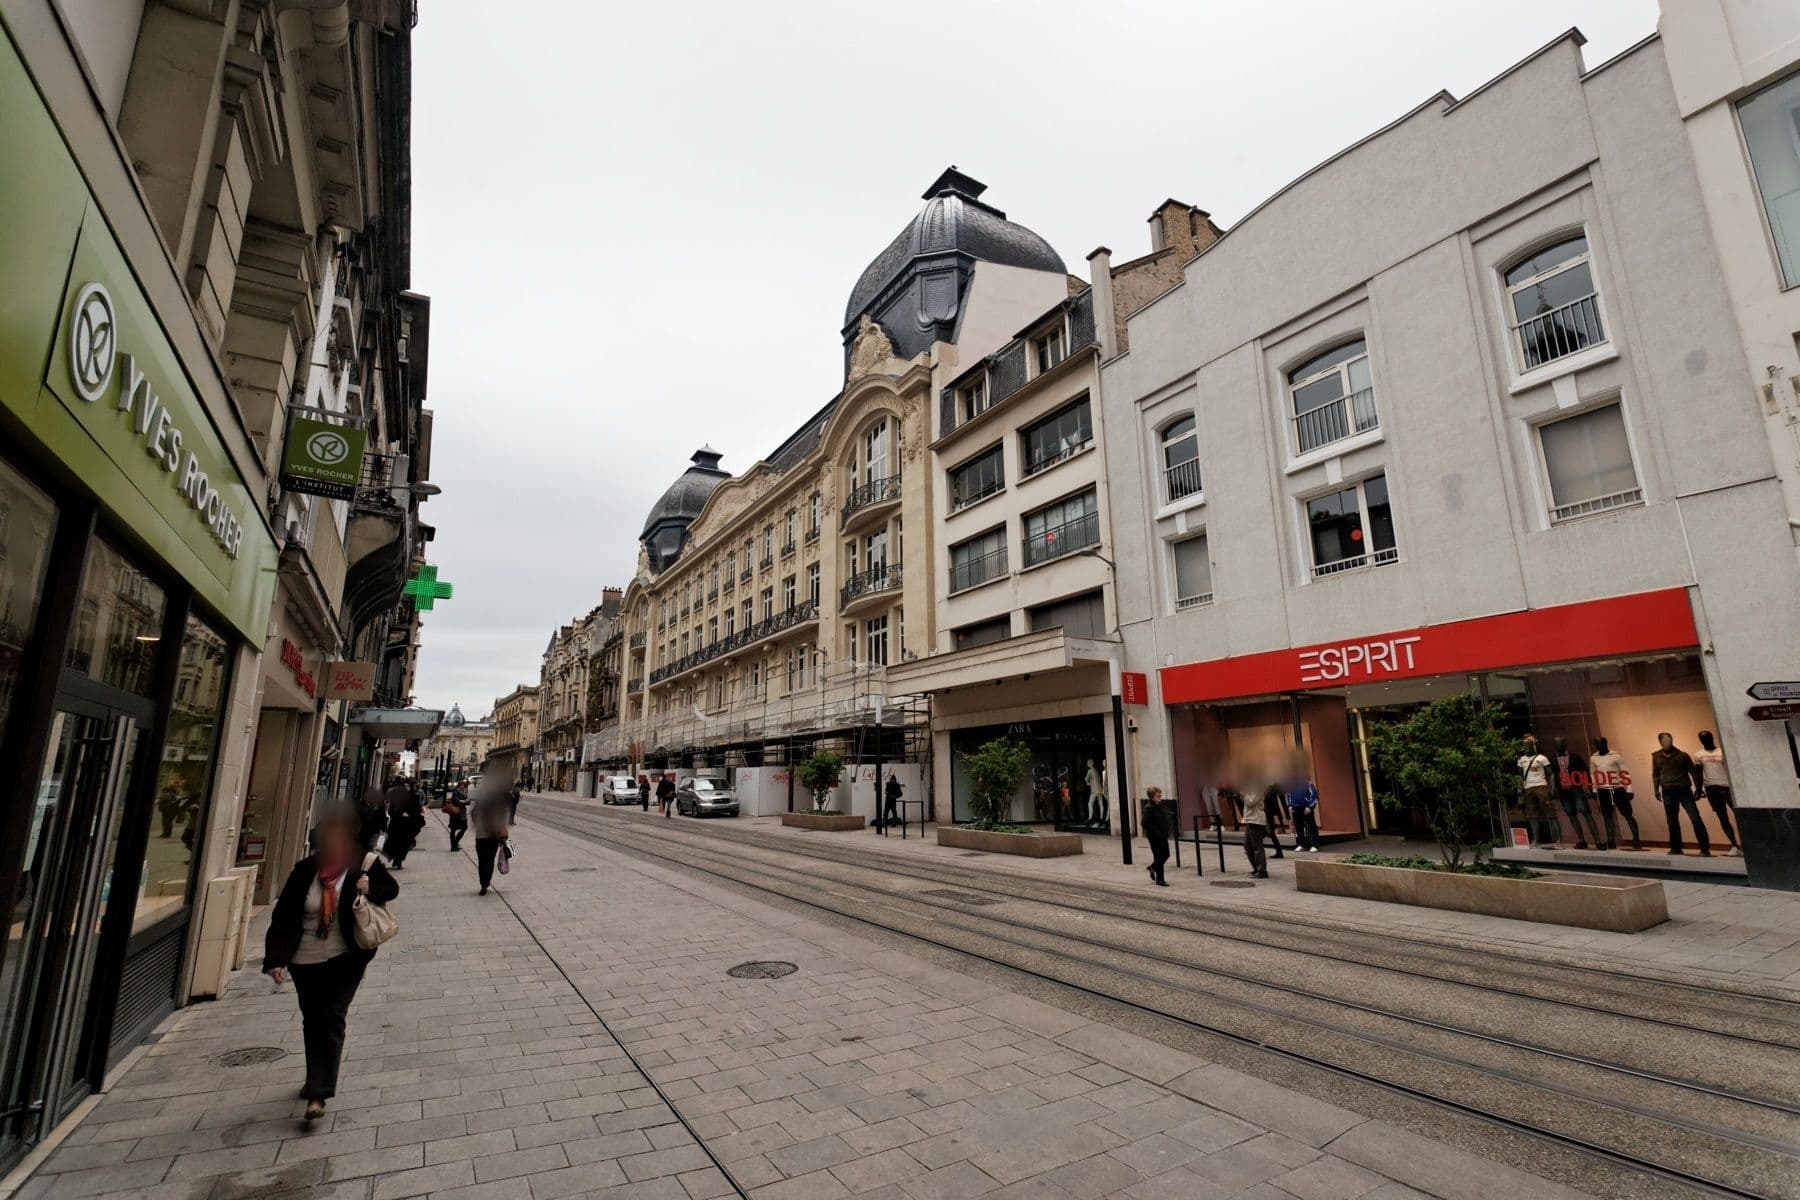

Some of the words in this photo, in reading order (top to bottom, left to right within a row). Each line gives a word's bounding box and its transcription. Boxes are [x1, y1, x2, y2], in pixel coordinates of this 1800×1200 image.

[118, 352, 183, 473] YVES
[178, 451, 243, 561] ROCHER
[291, 463, 314, 473] YVES
[316, 468, 354, 480] ROCHER
[1299, 636, 1421, 682] ESPRIT
[1127, 674, 1135, 702] ESPRIT
[1008, 724, 1032, 735] ZARA
[1558, 769, 1632, 787] SOLDES
